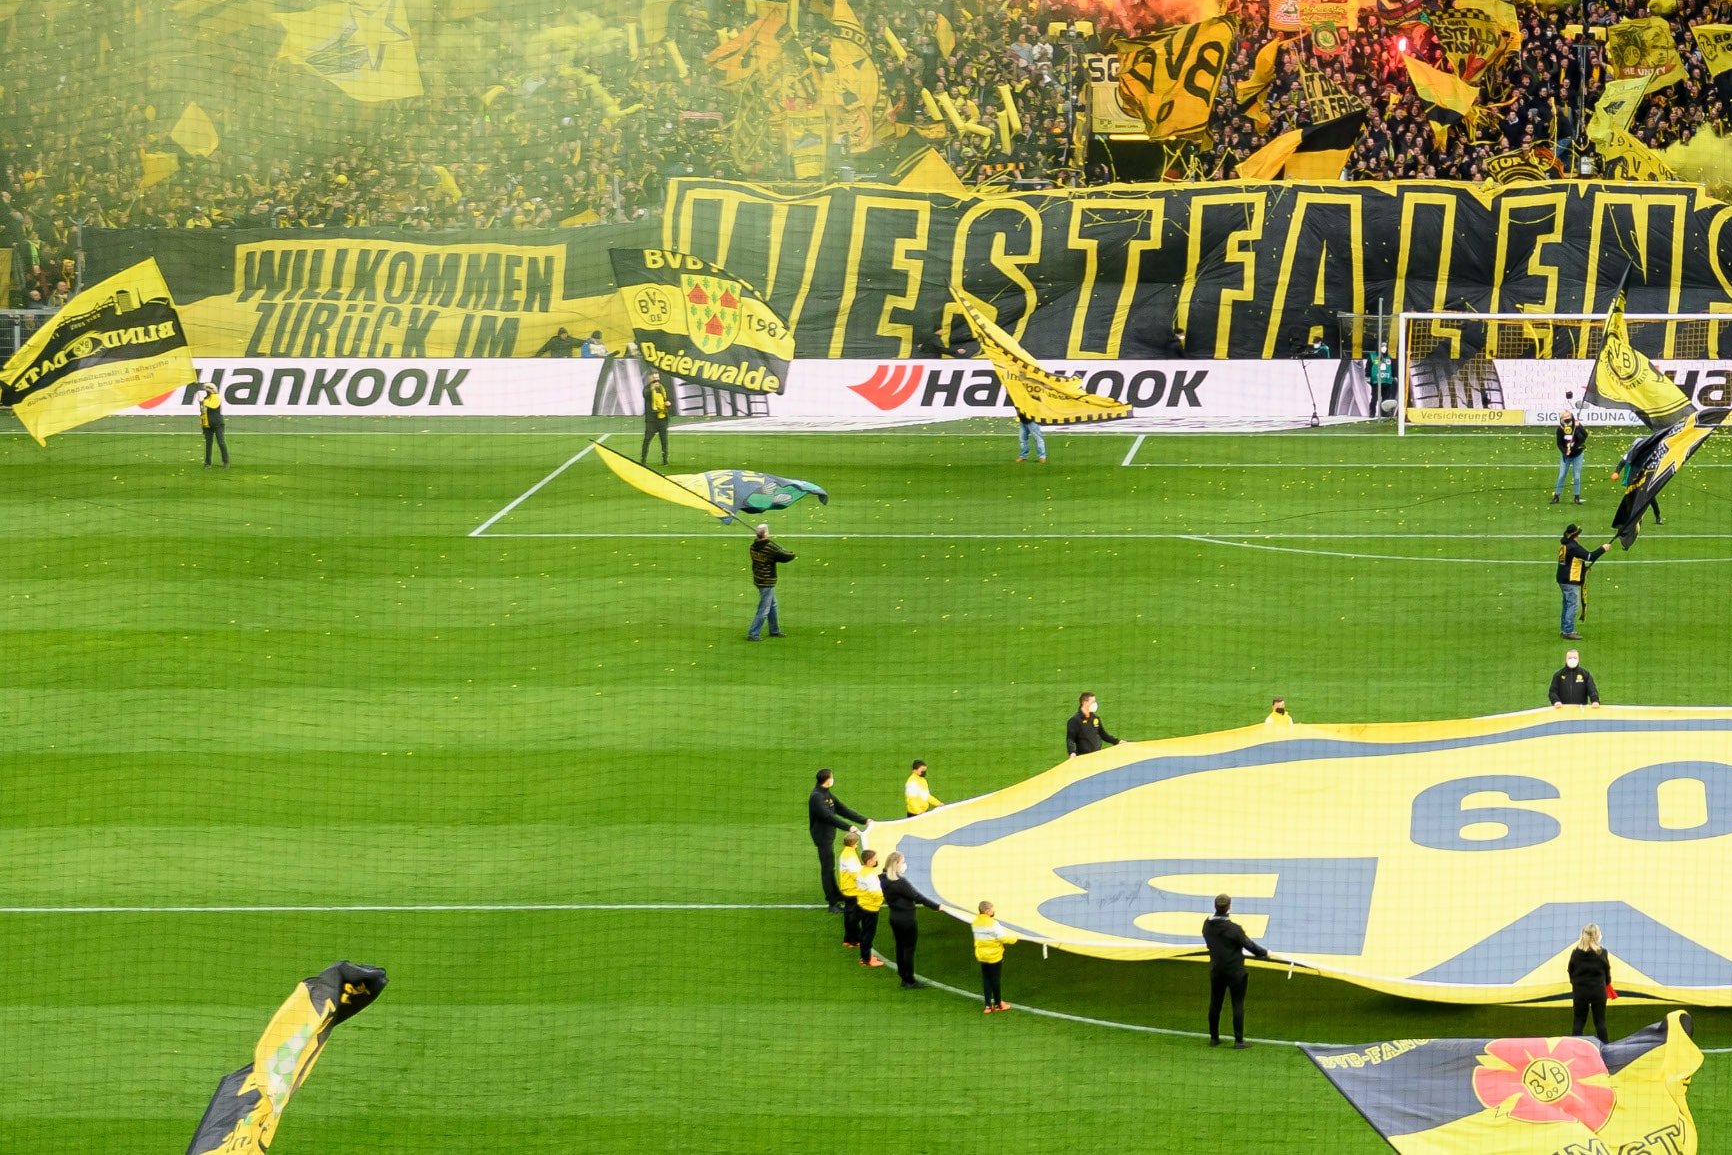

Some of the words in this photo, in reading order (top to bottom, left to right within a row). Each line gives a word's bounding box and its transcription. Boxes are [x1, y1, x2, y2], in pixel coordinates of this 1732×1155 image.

[239, 246, 555, 313] WILLKOMMEN
[458, 311, 520, 358] IM
[641, 342, 781, 393] Dreierwalde
[1586, 412, 1626, 422] IDUNA
